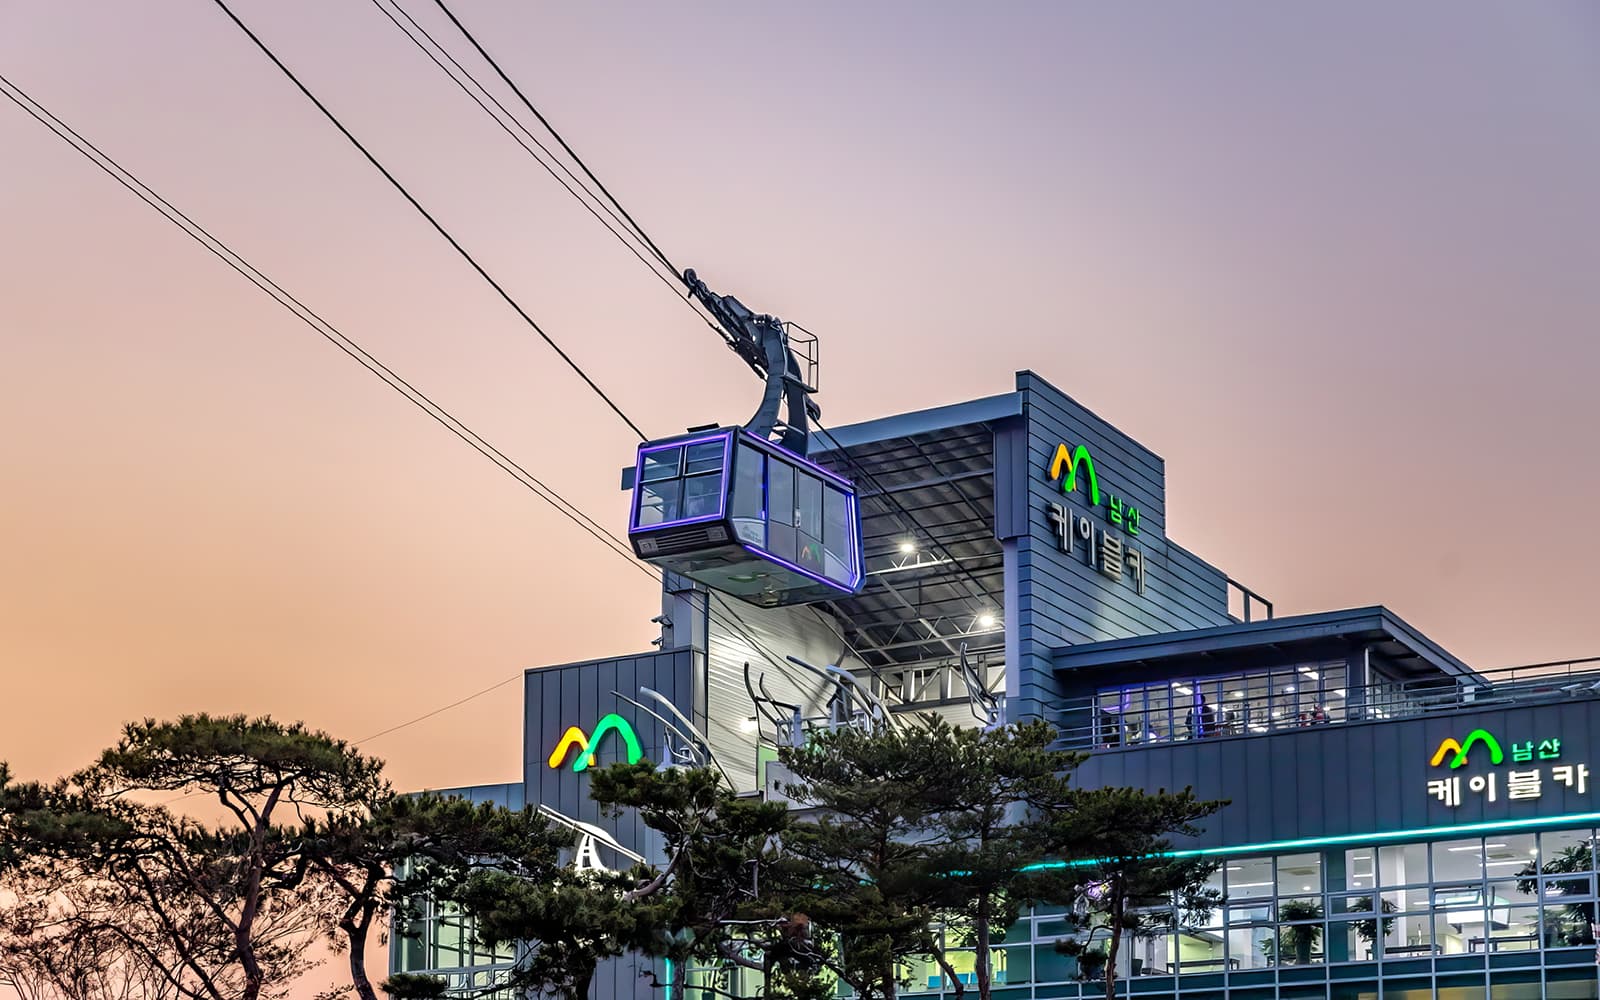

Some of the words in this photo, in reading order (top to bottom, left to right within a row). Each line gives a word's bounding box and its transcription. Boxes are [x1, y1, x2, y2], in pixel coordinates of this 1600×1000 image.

[1110, 494, 1140, 535] 남산
[1050, 502, 1146, 596] 케이블카
[1513, 738, 1561, 762] 남산
[1427, 763, 1590, 806] 케이블카
